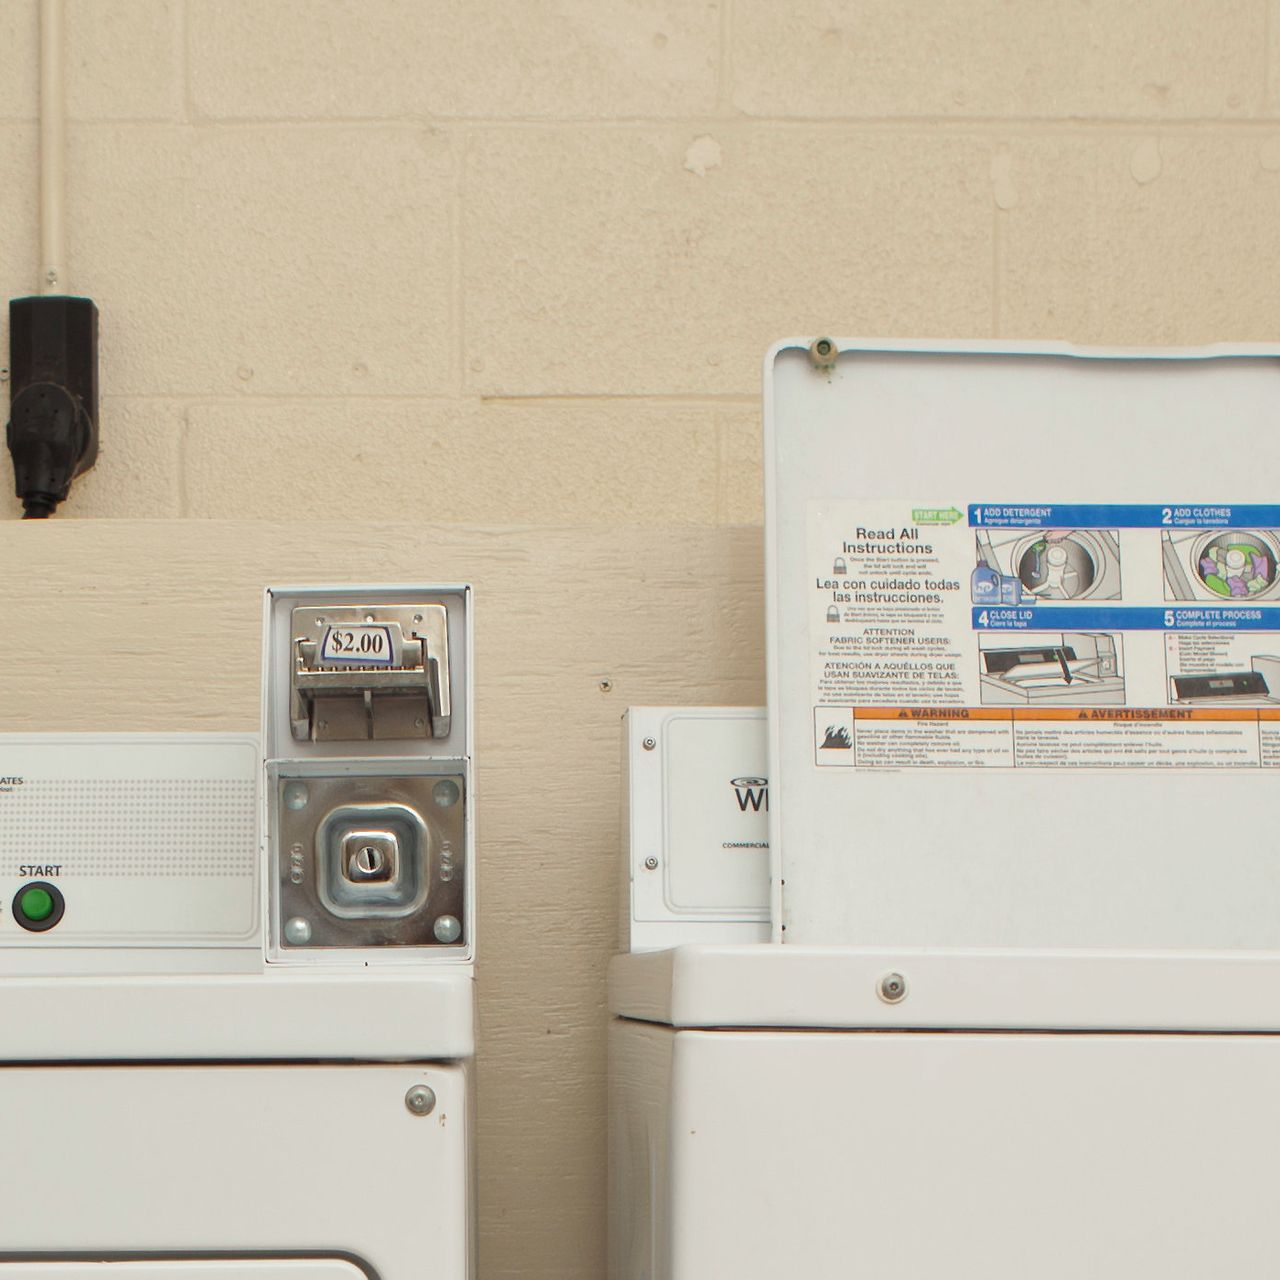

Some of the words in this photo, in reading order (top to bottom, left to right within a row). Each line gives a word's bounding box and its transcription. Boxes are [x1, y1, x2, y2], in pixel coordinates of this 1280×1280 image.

[974, 508, 981, 524] 1
[984, 508, 1001, 517] ADD
[1003, 508, 1052, 517] DETERGENT
[1162, 508, 1172, 524] 2
[1174, 508, 1191, 517] ADD
[1193, 508, 1231, 517] CLOTHES
[856, 528, 894, 540] Read
[900, 528, 918, 540] All
[843, 541, 933, 554] Instructions
[816, 578, 839, 589] Lea
[843, 581, 866, 589] con
[870, 579, 921, 590] cuidado
[925, 580, 960, 590] todas
[833, 591, 850, 602] las
[855, 591, 944, 603] instrucciones.
[979, 611, 988, 627] 4
[990, 611, 1017, 619] CLOSE
[1020, 611, 1032, 619] LID
[1164, 610, 1174, 626] 5
[1176, 610, 1220, 619] COMPLETE
[1223, 610, 1261, 619] PROCESS
[331, 631, 384, 654] $2.00
[884, 662, 933, 670] AQUÉLLOS
[912, 709, 969, 718] WARNING
[1091, 709, 1193, 718] AVERTISSEMENT
[19, 865, 62, 877] START
